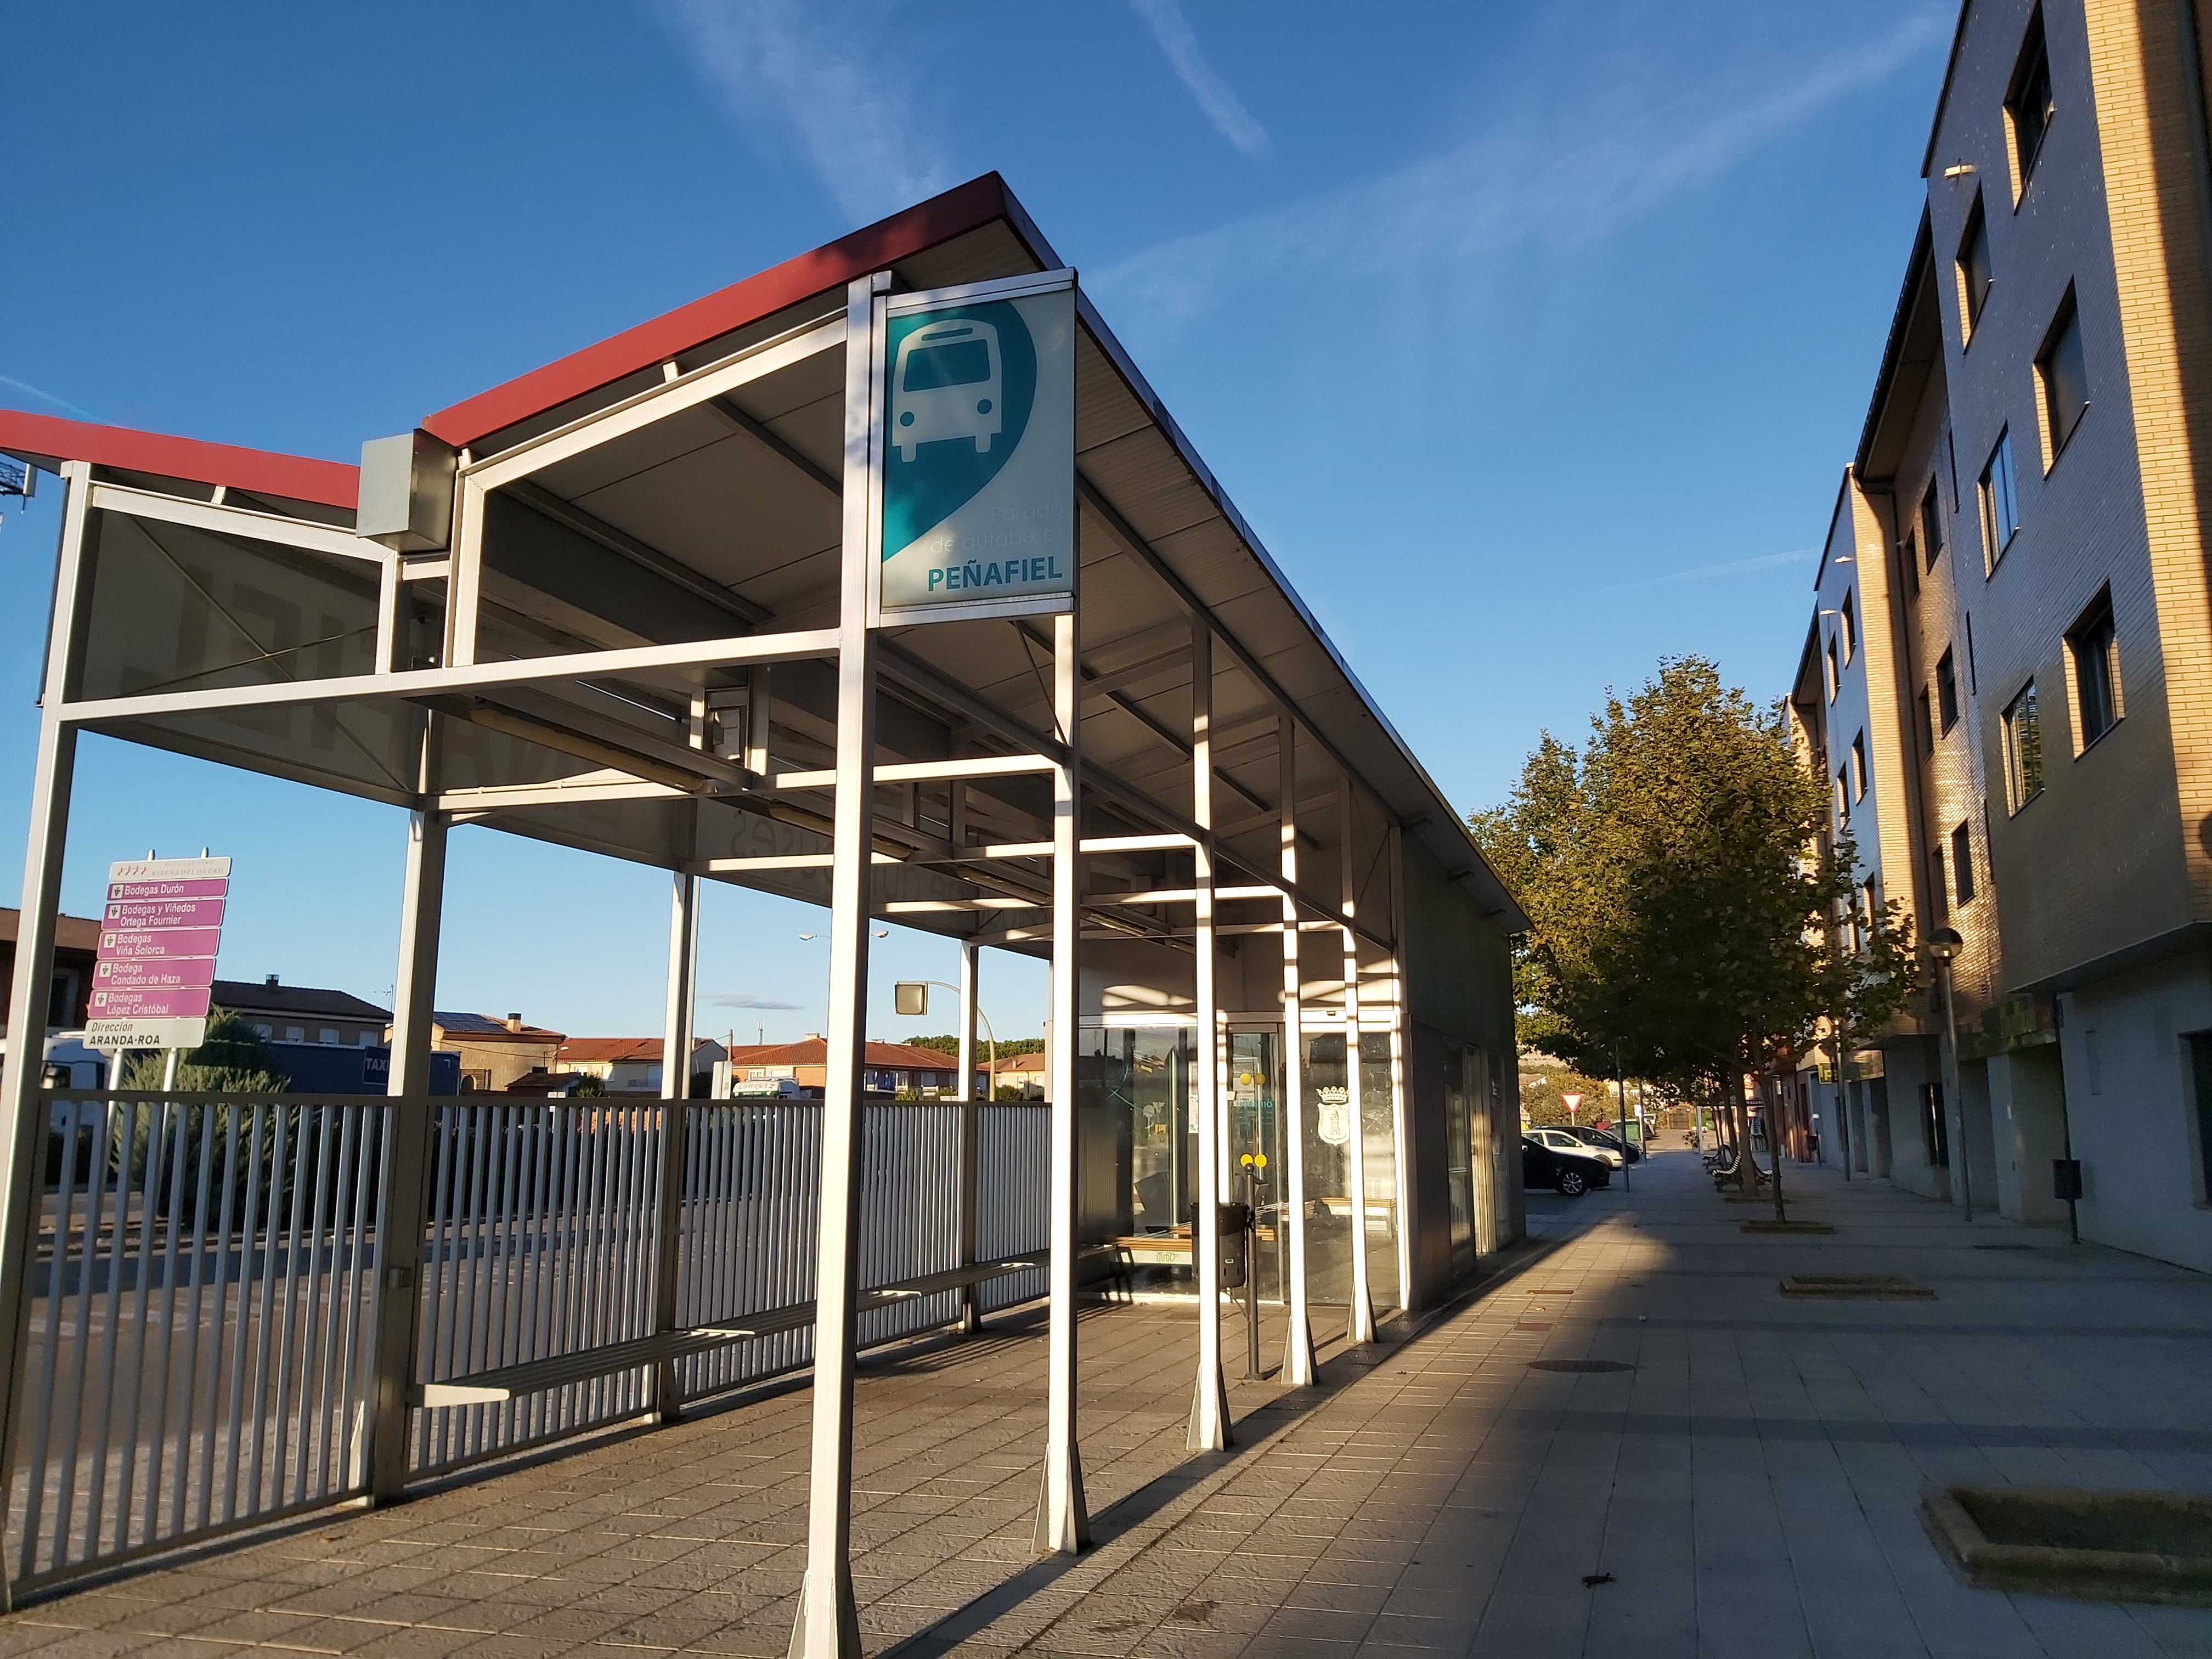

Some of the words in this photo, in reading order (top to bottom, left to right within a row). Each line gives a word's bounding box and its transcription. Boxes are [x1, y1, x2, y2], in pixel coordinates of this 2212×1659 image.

[991, 501, 1063, 522] Parada
[930, 535, 955, 553] de
[963, 528, 1064, 550] autobuses
[928, 556, 1063, 591] PEÑAFIEL
[125, 885, 159, 896] Bodegas
[161, 884, 184, 894] Durón
[122, 905, 156, 916] Bodegas
[157, 906, 162, 915] y
[165, 903, 196, 913] Viñedos
[120, 917, 146, 927] Ortega
[149, 915, 181, 926] Fournier
[117, 934, 151, 946] Bodegas
[116, 945, 132, 955] Viña
[134, 945, 165, 955] Solorca
[112, 963, 142, 974] Bodega
[111, 975, 145, 985] Condado
[148, 975, 158, 984] de
[161, 974, 180, 983] Haza
[108, 993, 142, 1005] Bodegas
[107, 1005, 131, 1016] López
[133, 1004, 168, 1014] Cristóbal
[92, 1023, 133, 1032] Dirección
[89, 1035, 160, 1045] ARANDA-ROA
